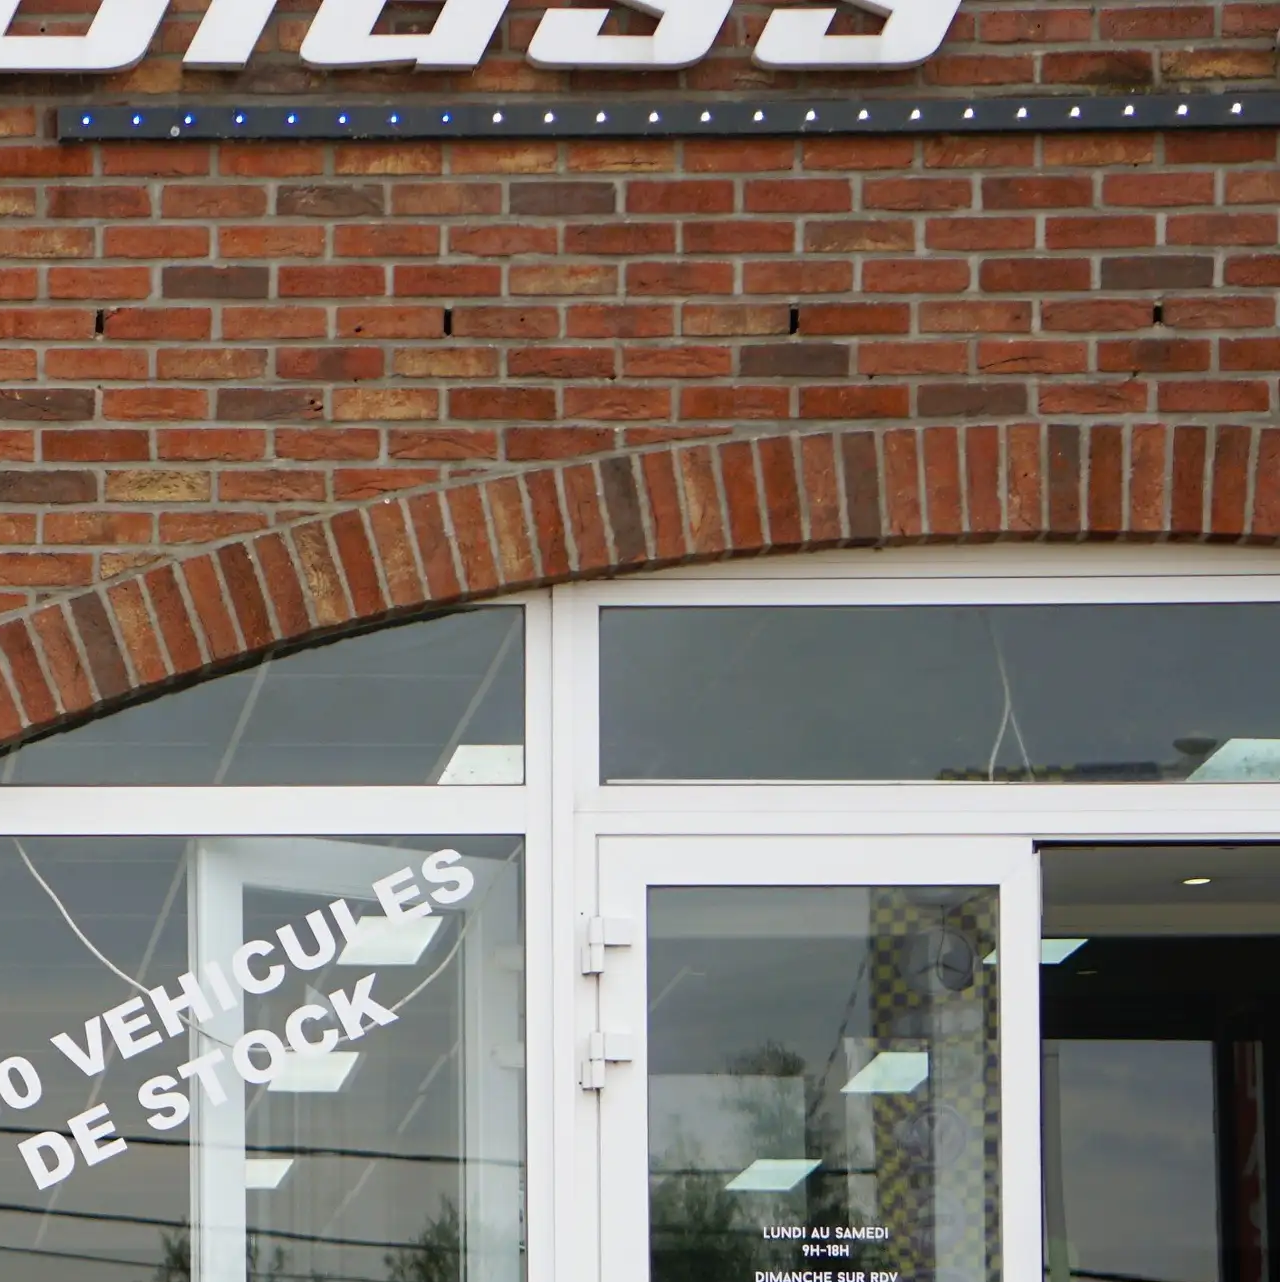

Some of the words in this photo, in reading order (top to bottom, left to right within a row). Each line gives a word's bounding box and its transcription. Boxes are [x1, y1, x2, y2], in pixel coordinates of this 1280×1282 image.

[51, 848, 476, 1078] VEHICULES
[17, 1102, 128, 1191] DE
[137, 972, 400, 1131] STOCK
[763, 1226, 806, 1240] LUNDI
[811, 1226, 831, 1240] AU
[835, 1226, 889, 1240] SAMEDI
[802, 1244, 850, 1258] 9H-18H
